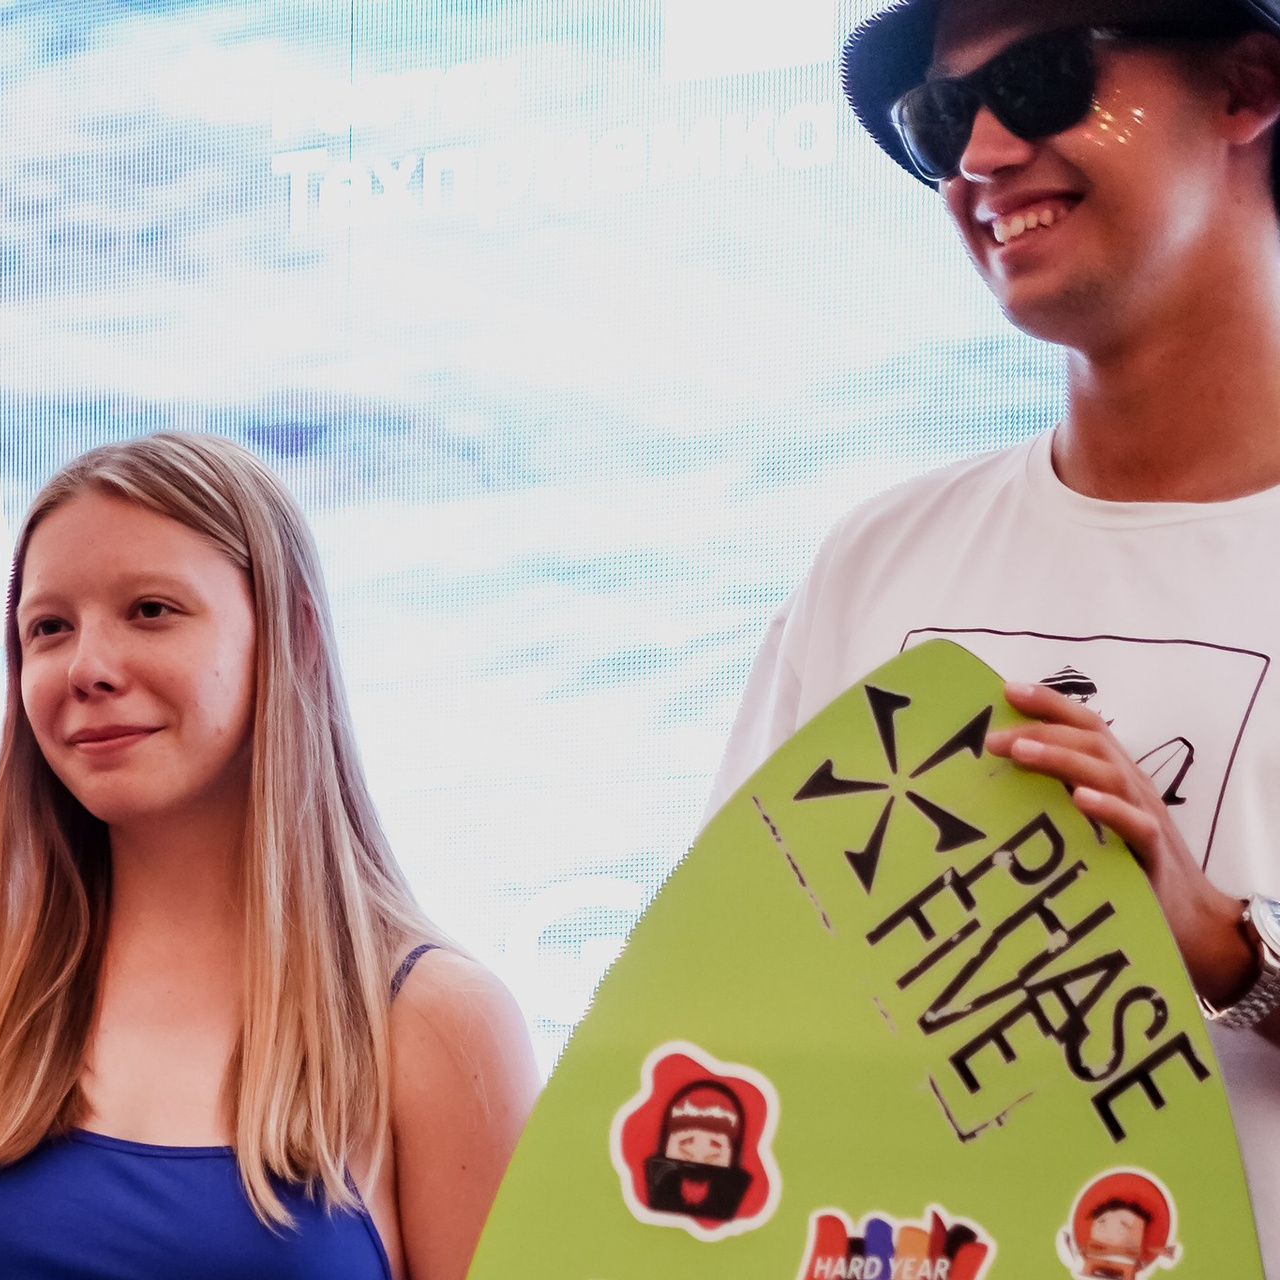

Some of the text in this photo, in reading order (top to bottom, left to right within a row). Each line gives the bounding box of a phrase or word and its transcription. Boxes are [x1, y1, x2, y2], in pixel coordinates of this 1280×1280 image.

[866, 868, 1063, 1094] FIVE
[958, 812, 1212, 1144] PHASE
[813, 1255, 883, 1280] HARD
